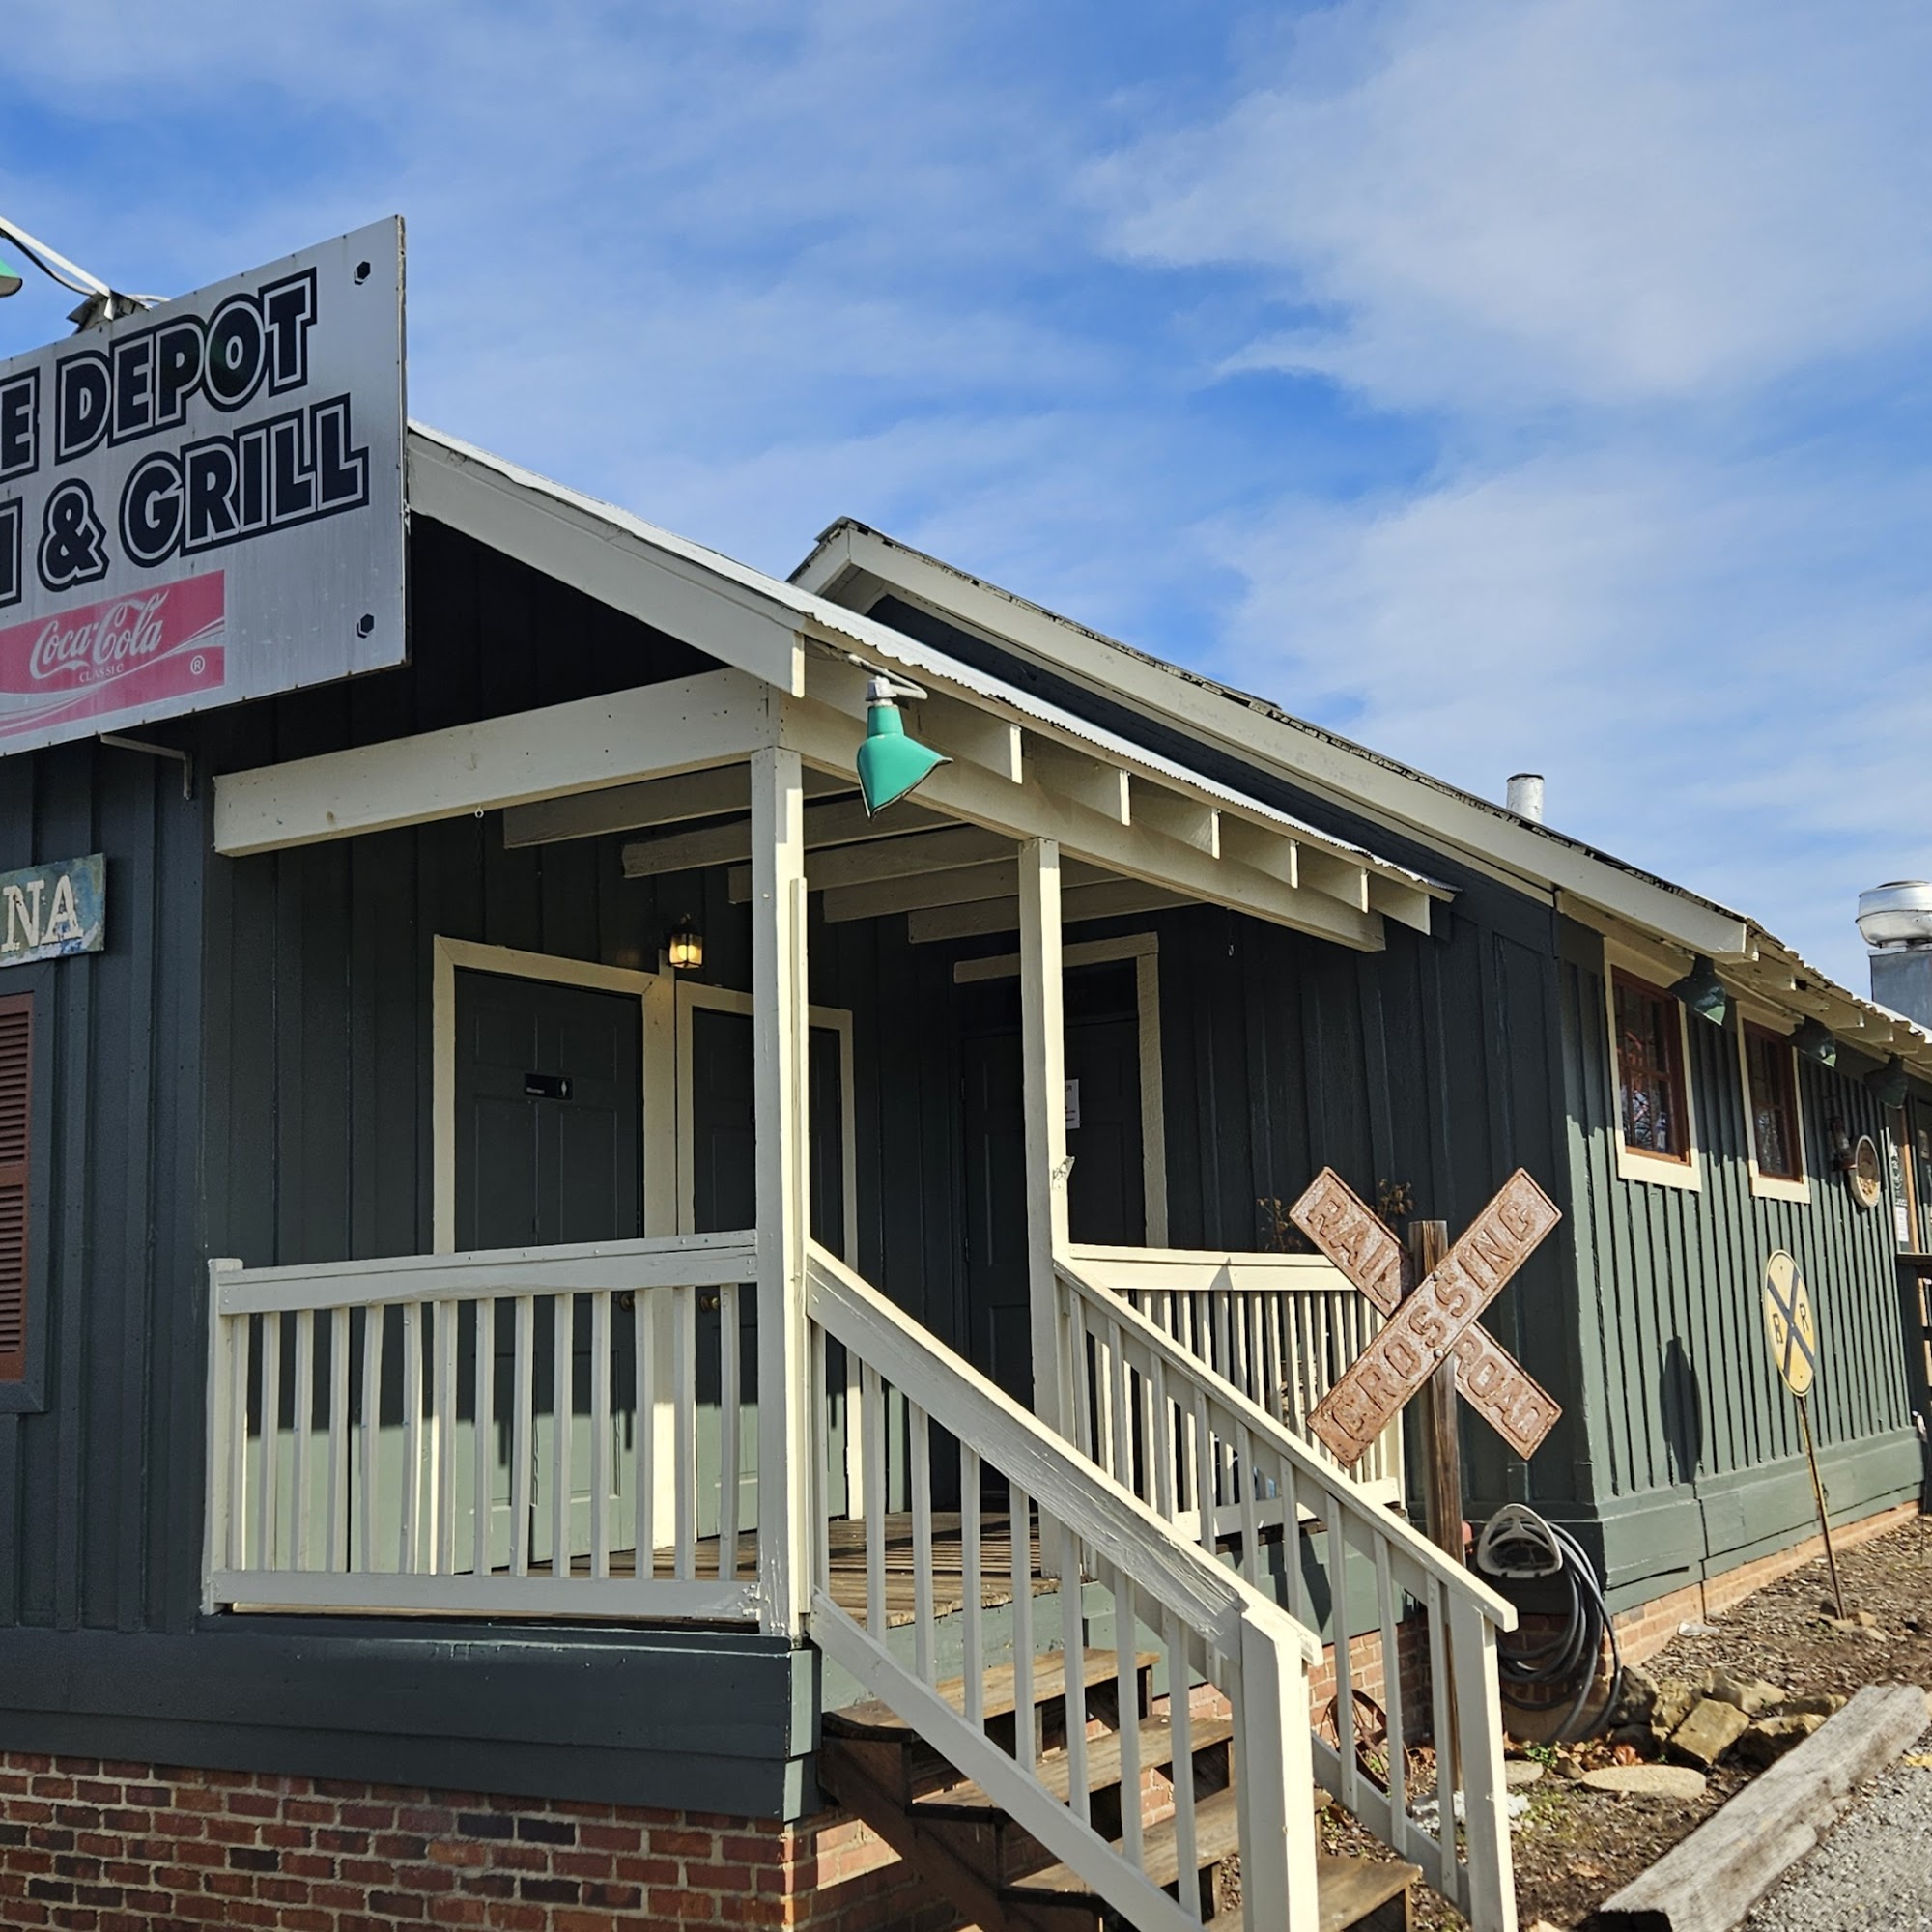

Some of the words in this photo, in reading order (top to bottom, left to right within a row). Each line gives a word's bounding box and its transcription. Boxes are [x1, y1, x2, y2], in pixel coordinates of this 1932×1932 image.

[54, 267, 317, 466] DEPOT
[37, 478, 110, 592] &
[118, 393, 369, 568] GRILL
[1306, 1186, 1401, 1306] RAIL
[1454, 1330, 1545, 1443] ROAD
[1330, 1200, 1536, 1443] CROSSING
